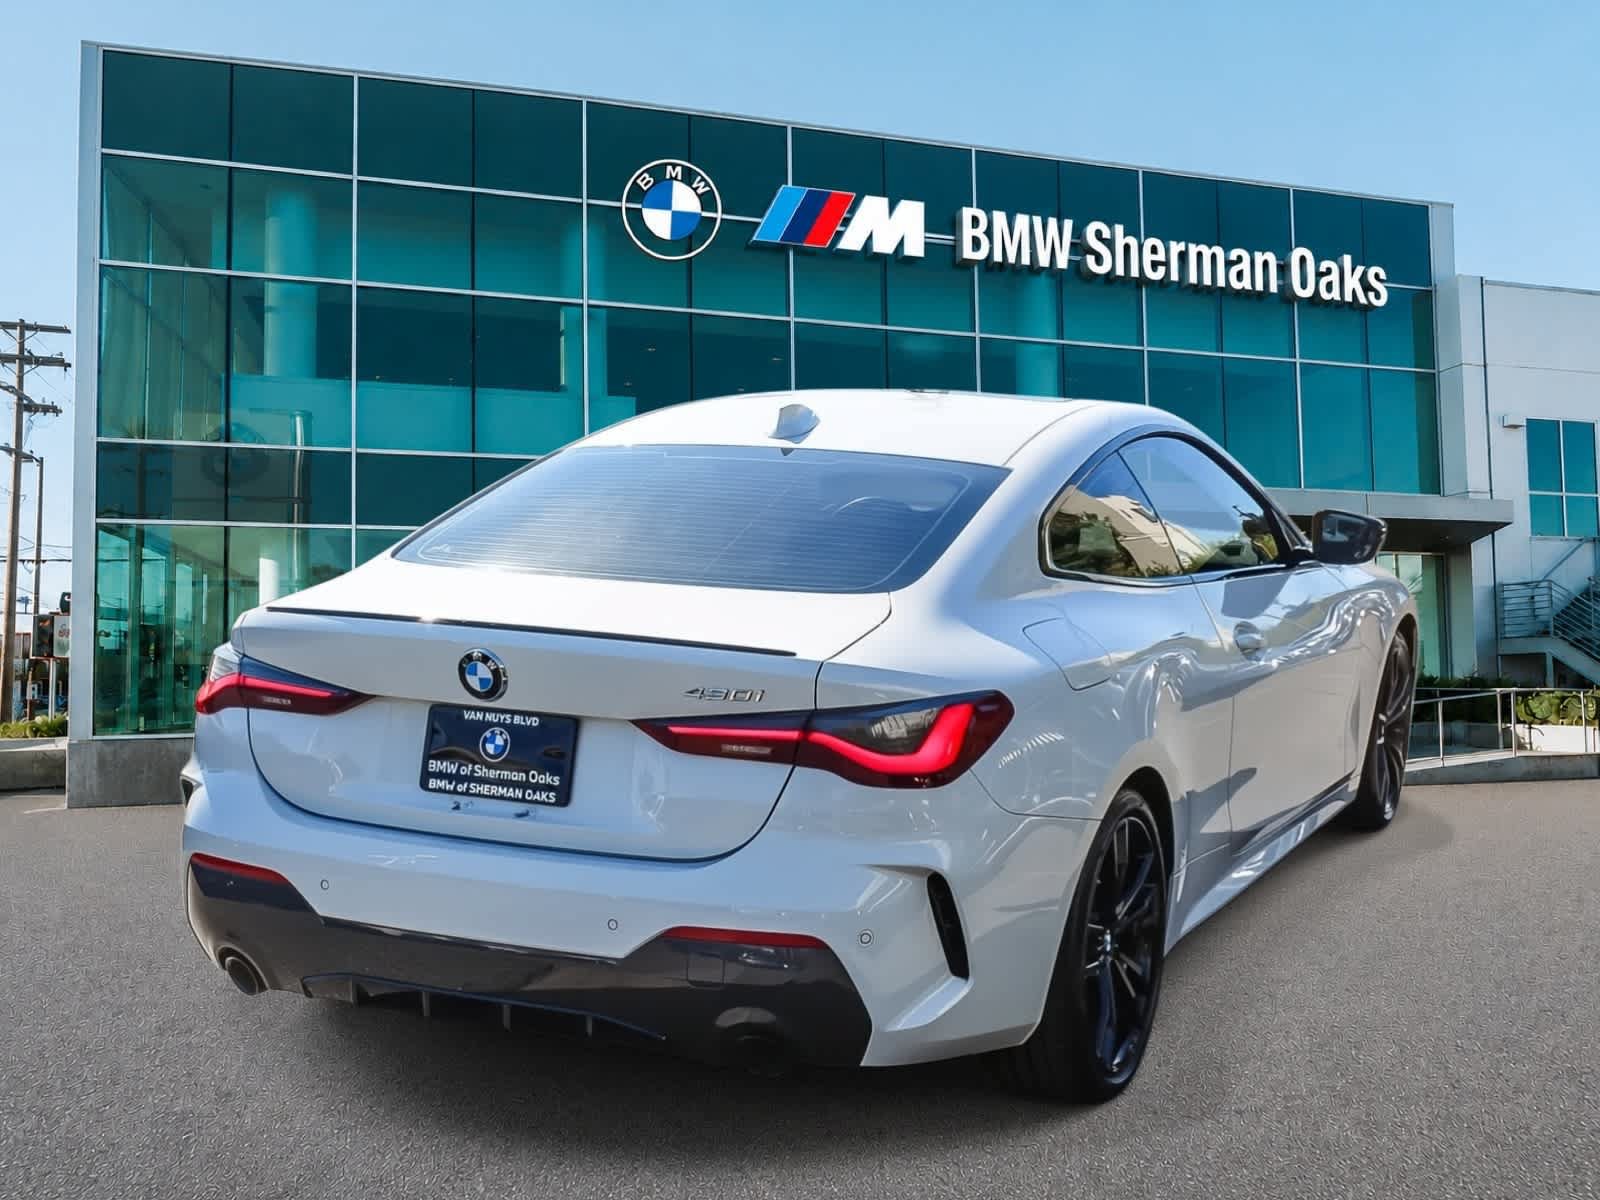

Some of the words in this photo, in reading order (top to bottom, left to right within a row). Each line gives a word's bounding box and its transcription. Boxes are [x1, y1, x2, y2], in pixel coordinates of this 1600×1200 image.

[636, 165, 712, 196] BMW
[960, 206, 1073, 271] BMW
[1083, 220, 1279, 294] Sherman
[1289, 246, 1389, 308] Oaks
[463, 710, 485, 721] VAN
[485, 712, 512, 724] NUYS
[513, 715, 540, 727] BLVD
[428, 760, 458, 775] BMW
[460, 764, 473, 776] of
[473, 765, 526, 782] Sherman
[528, 770, 561, 786] Oaks
[428, 778, 456, 792] BMW
[457, 781, 468, 792] of
[469, 782, 523, 799] SHERMAN
[525, 789, 557, 803] OAKS
